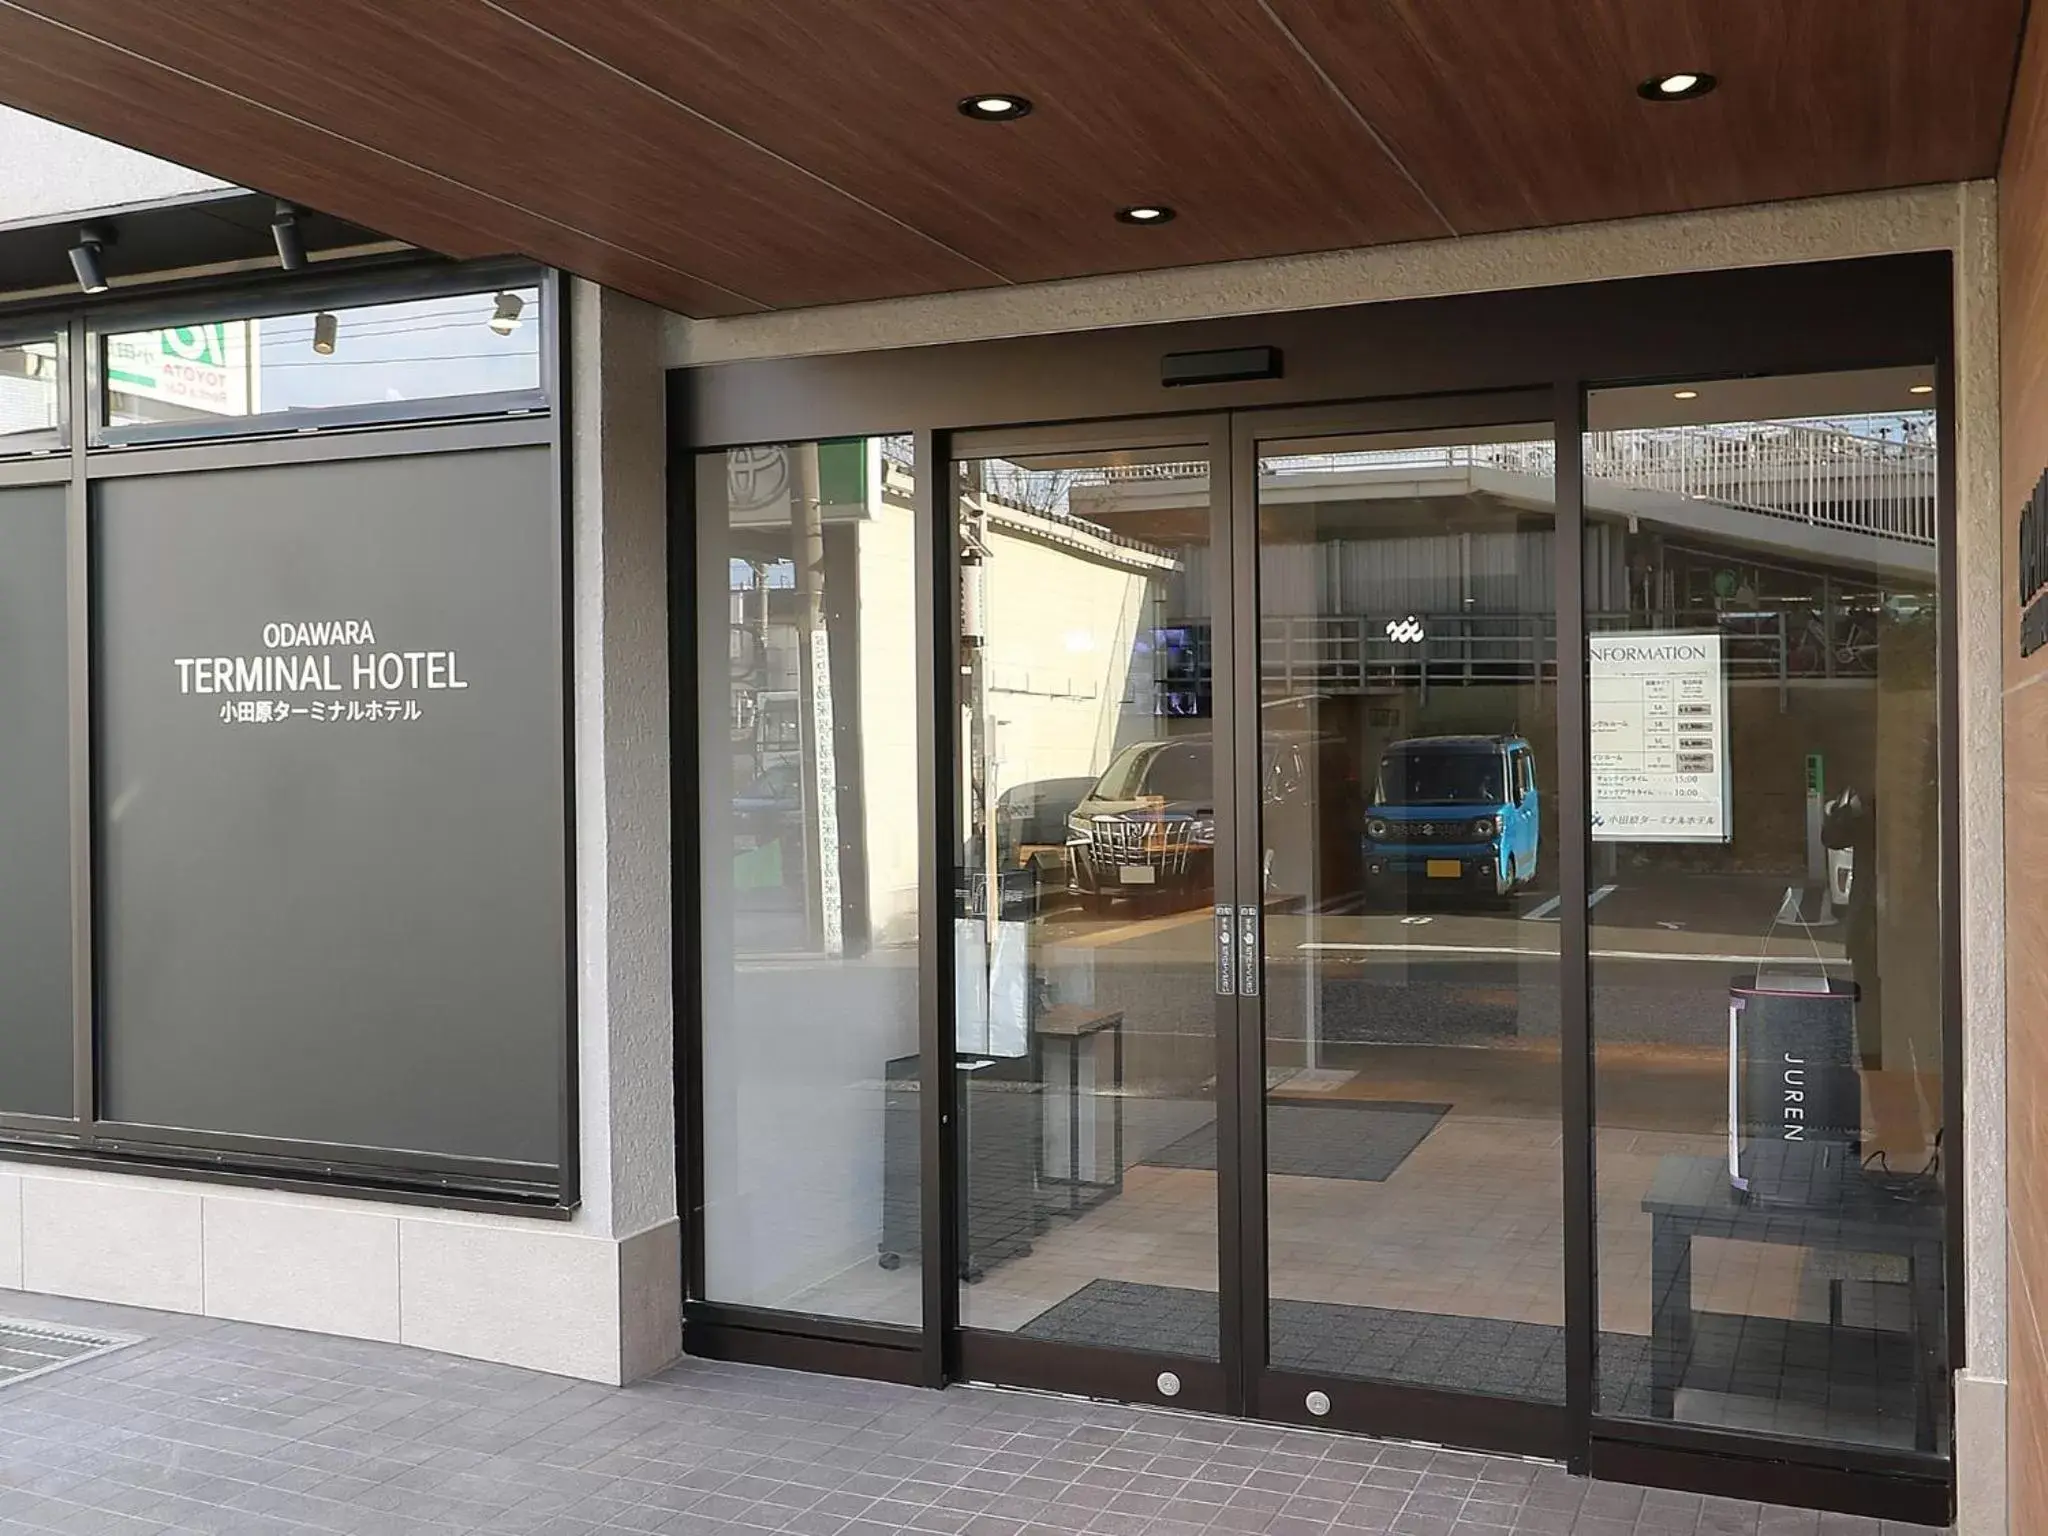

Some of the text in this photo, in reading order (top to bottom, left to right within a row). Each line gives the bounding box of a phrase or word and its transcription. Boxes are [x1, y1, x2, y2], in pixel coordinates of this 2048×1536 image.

[263, 619, 375, 648] ODAWARA
[174, 651, 468, 693] TERMINAL HOTEL
[220, 699, 422, 723] 小田原ターミナルホテル
[1783, 1052, 1805, 1142] JUREN
